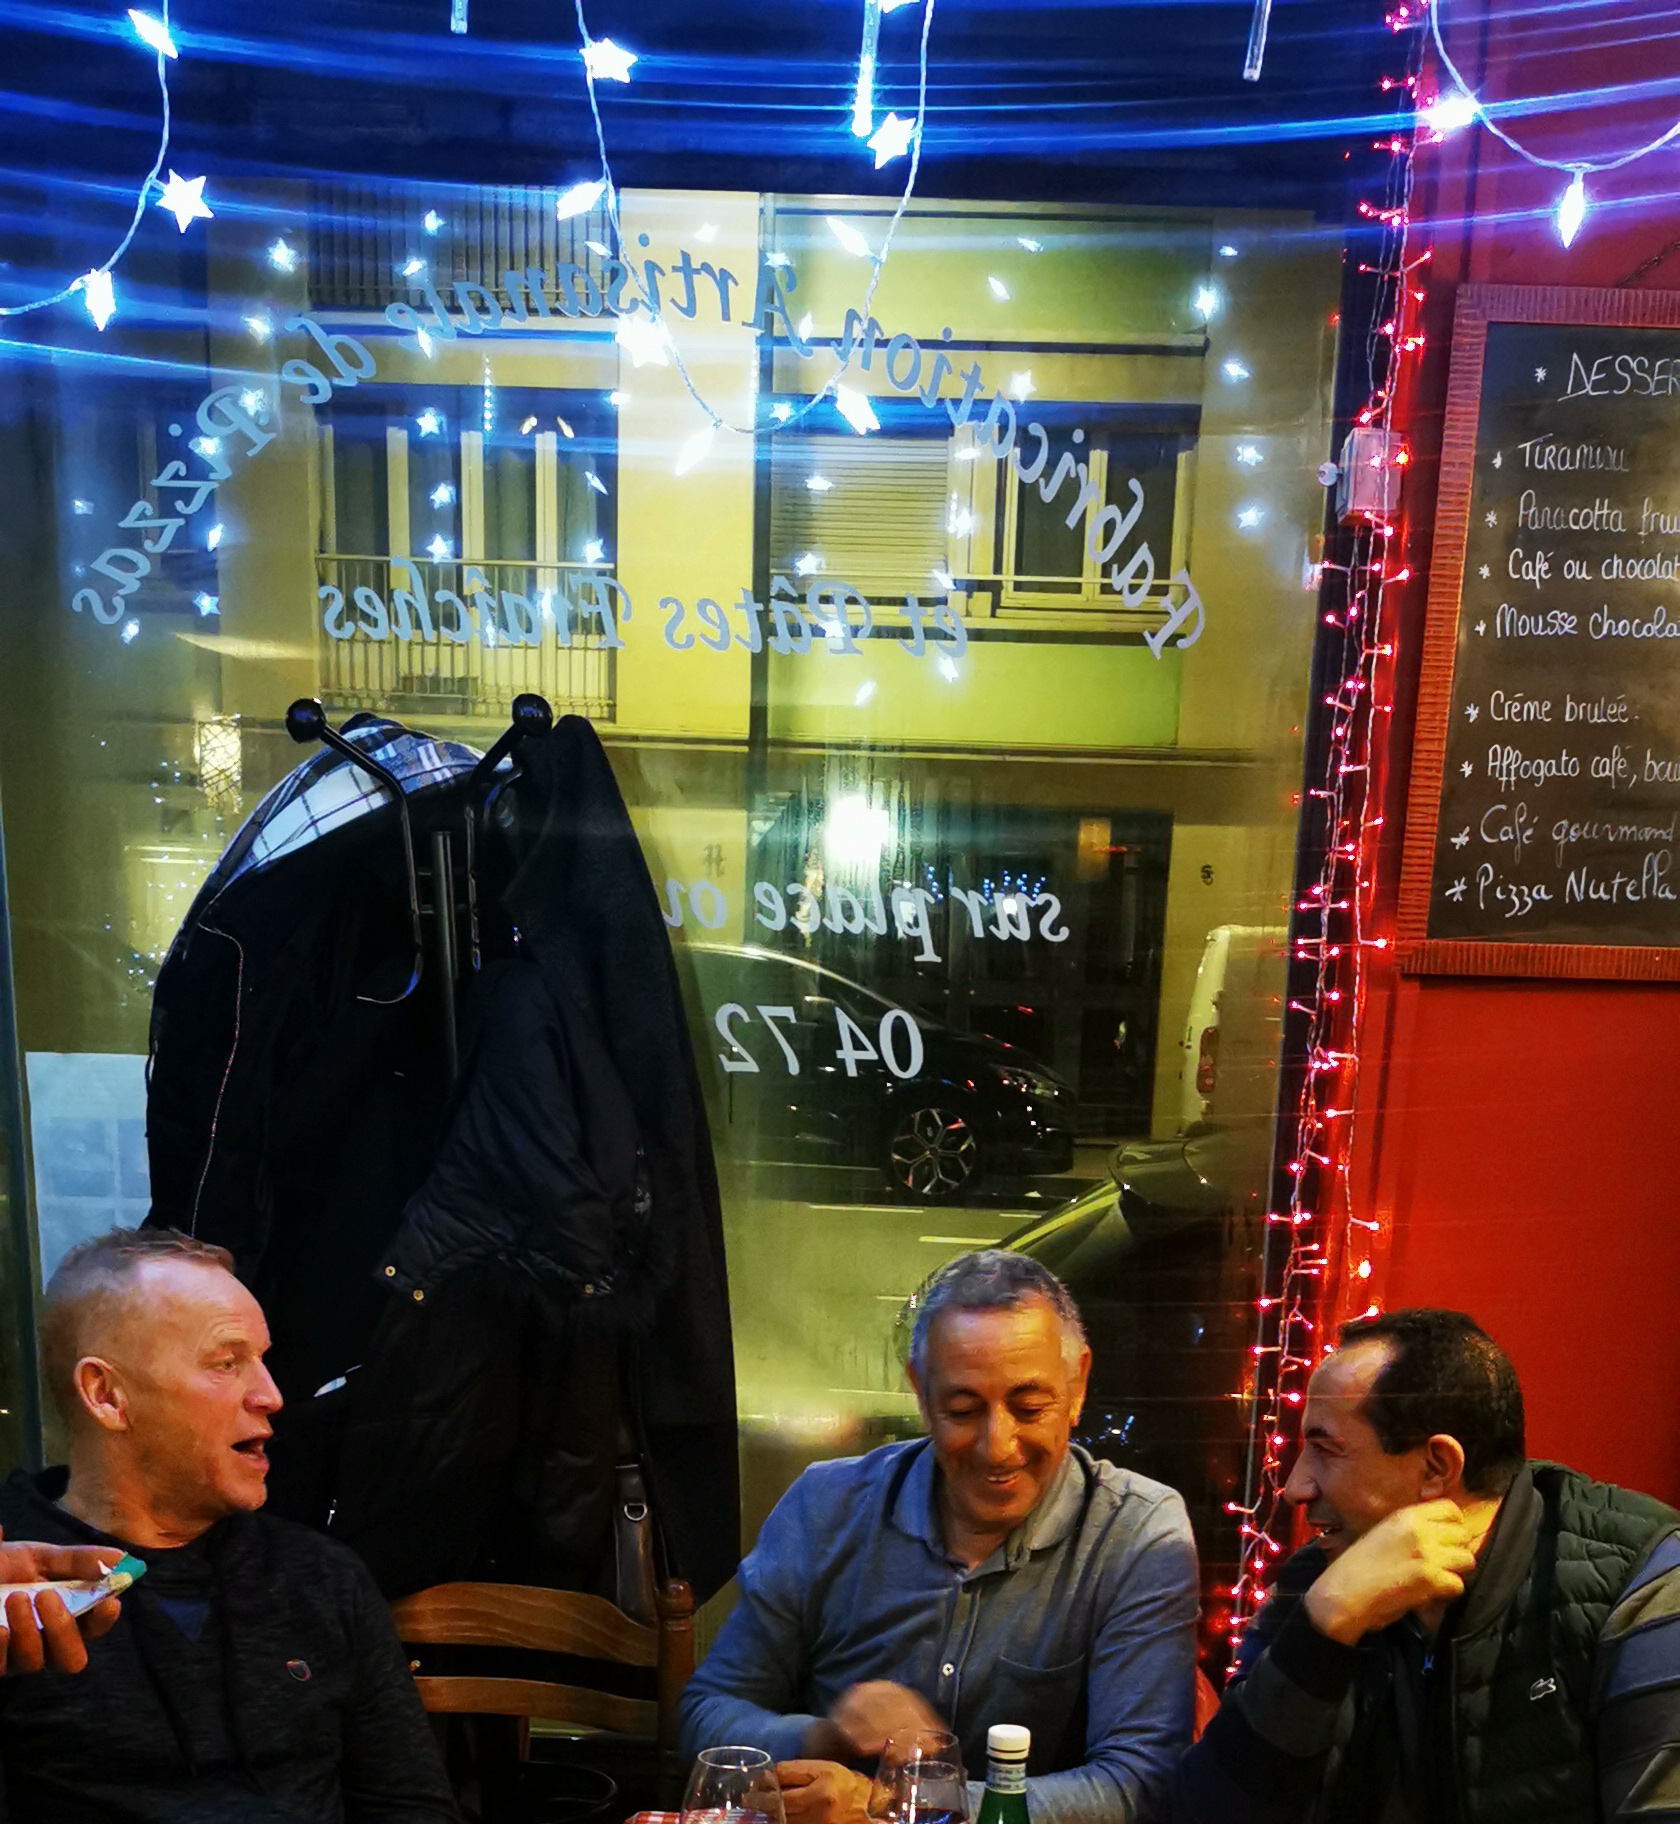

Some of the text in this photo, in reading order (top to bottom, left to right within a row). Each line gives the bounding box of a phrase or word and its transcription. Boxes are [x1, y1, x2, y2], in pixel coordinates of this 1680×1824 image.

[1518, 489, 1628, 532] Panacotta
[1508, 547, 1555, 590] Café
[1563, 559, 1593, 581] ou
[1496, 603, 1578, 639] Mousse
[1487, 743, 1581, 792] Affogato
[1590, 744, 1638, 789] café,
[1479, 802, 1678, 868] Café gourmand
[1475, 849, 1678, 918] Pizza Nutella
